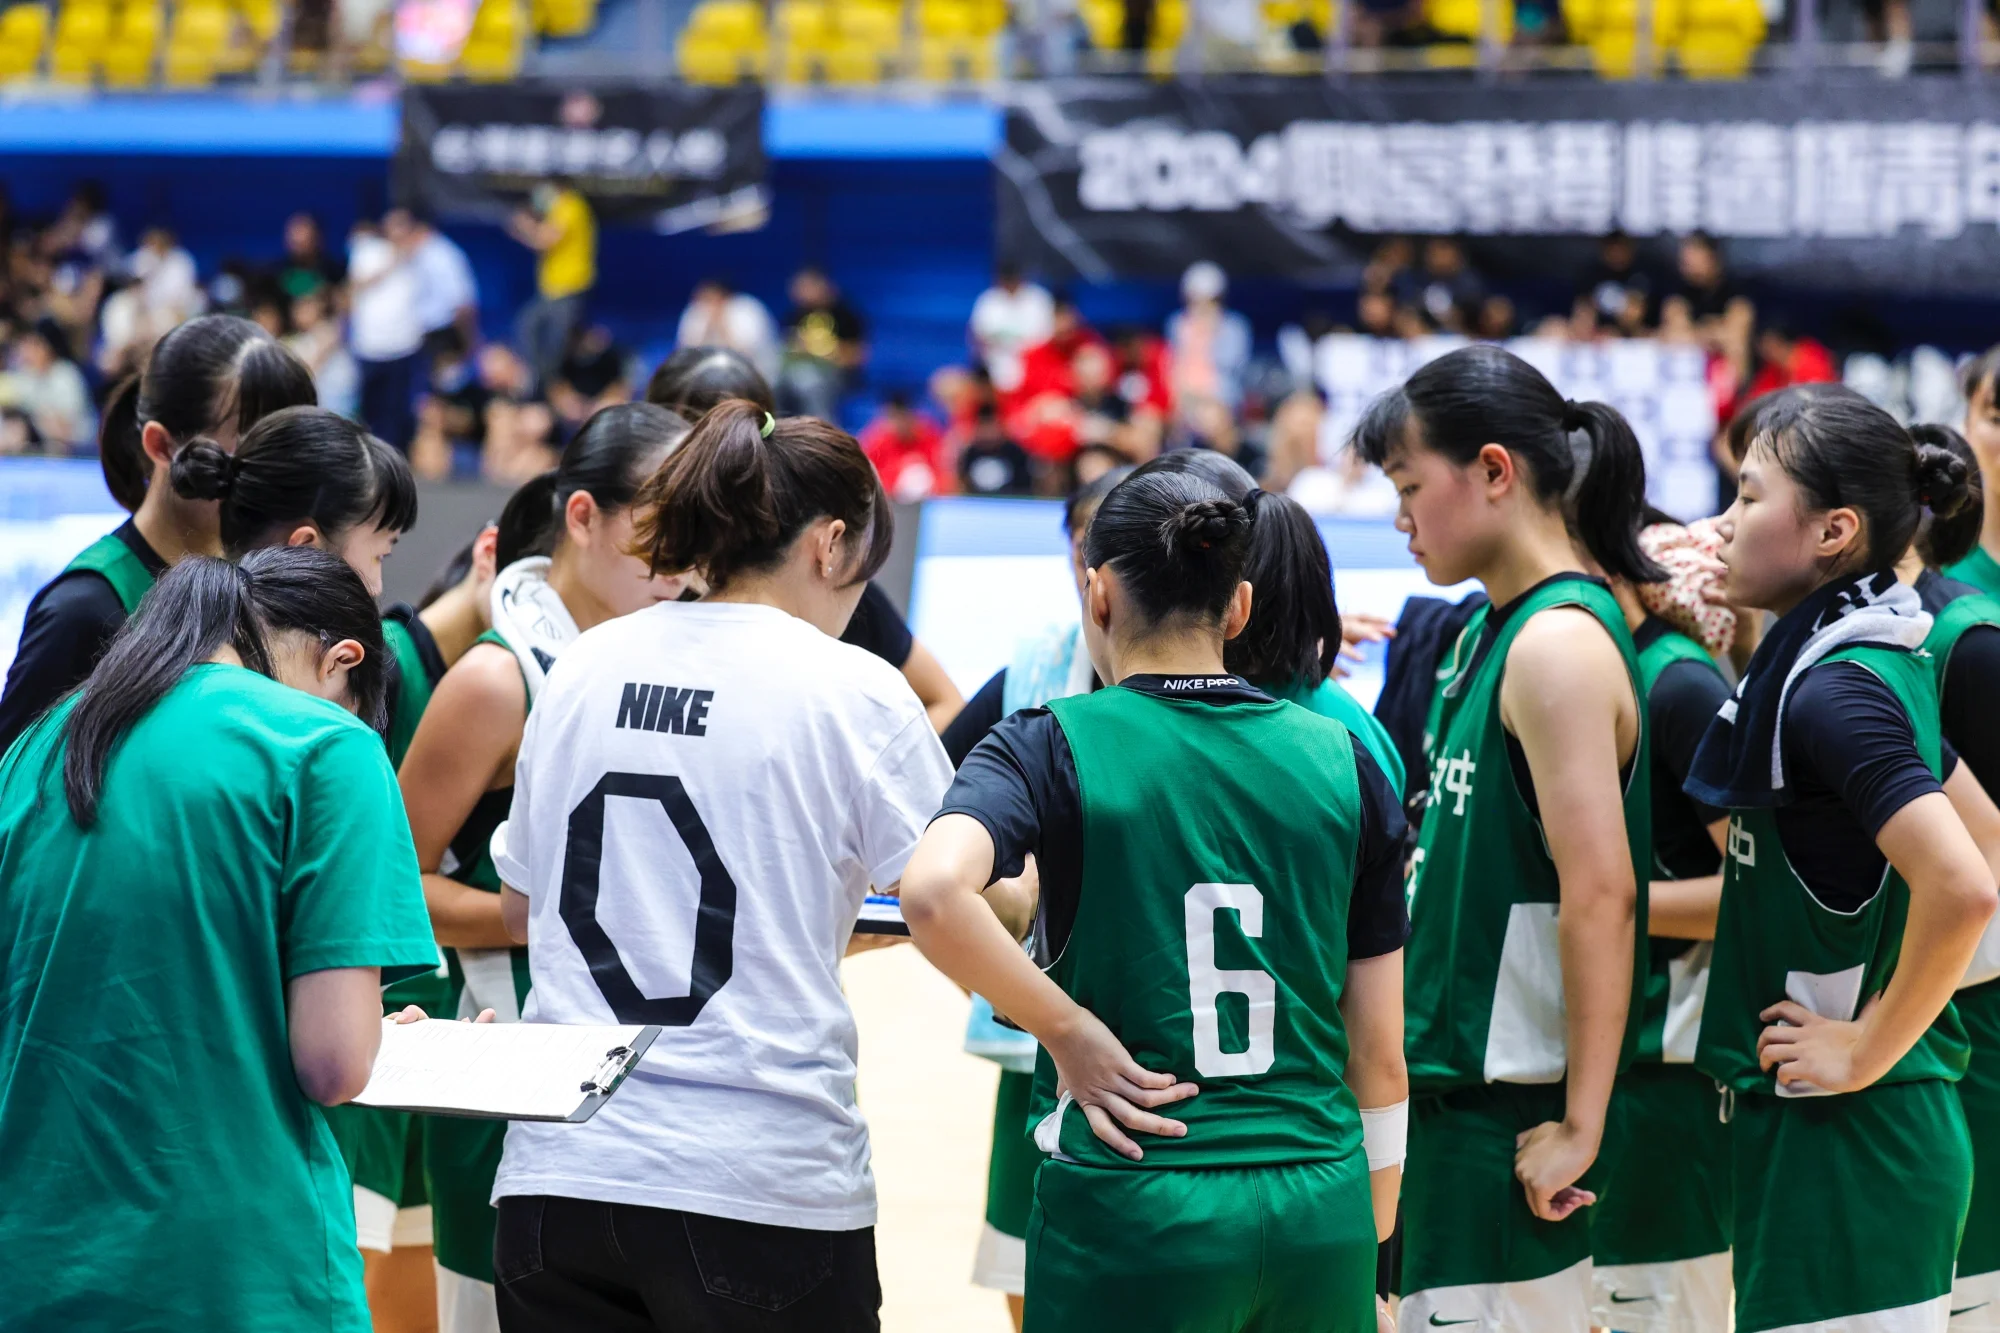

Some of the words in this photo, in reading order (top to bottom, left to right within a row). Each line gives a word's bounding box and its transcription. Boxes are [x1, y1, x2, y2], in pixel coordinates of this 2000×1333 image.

[615, 682, 714, 737] NIKE
[1163, 679, 1205, 690] NIKE
[1206, 678, 1239, 689] PRO
[558, 771, 737, 1027] 0
[1184, 882, 1276, 1078] 6
